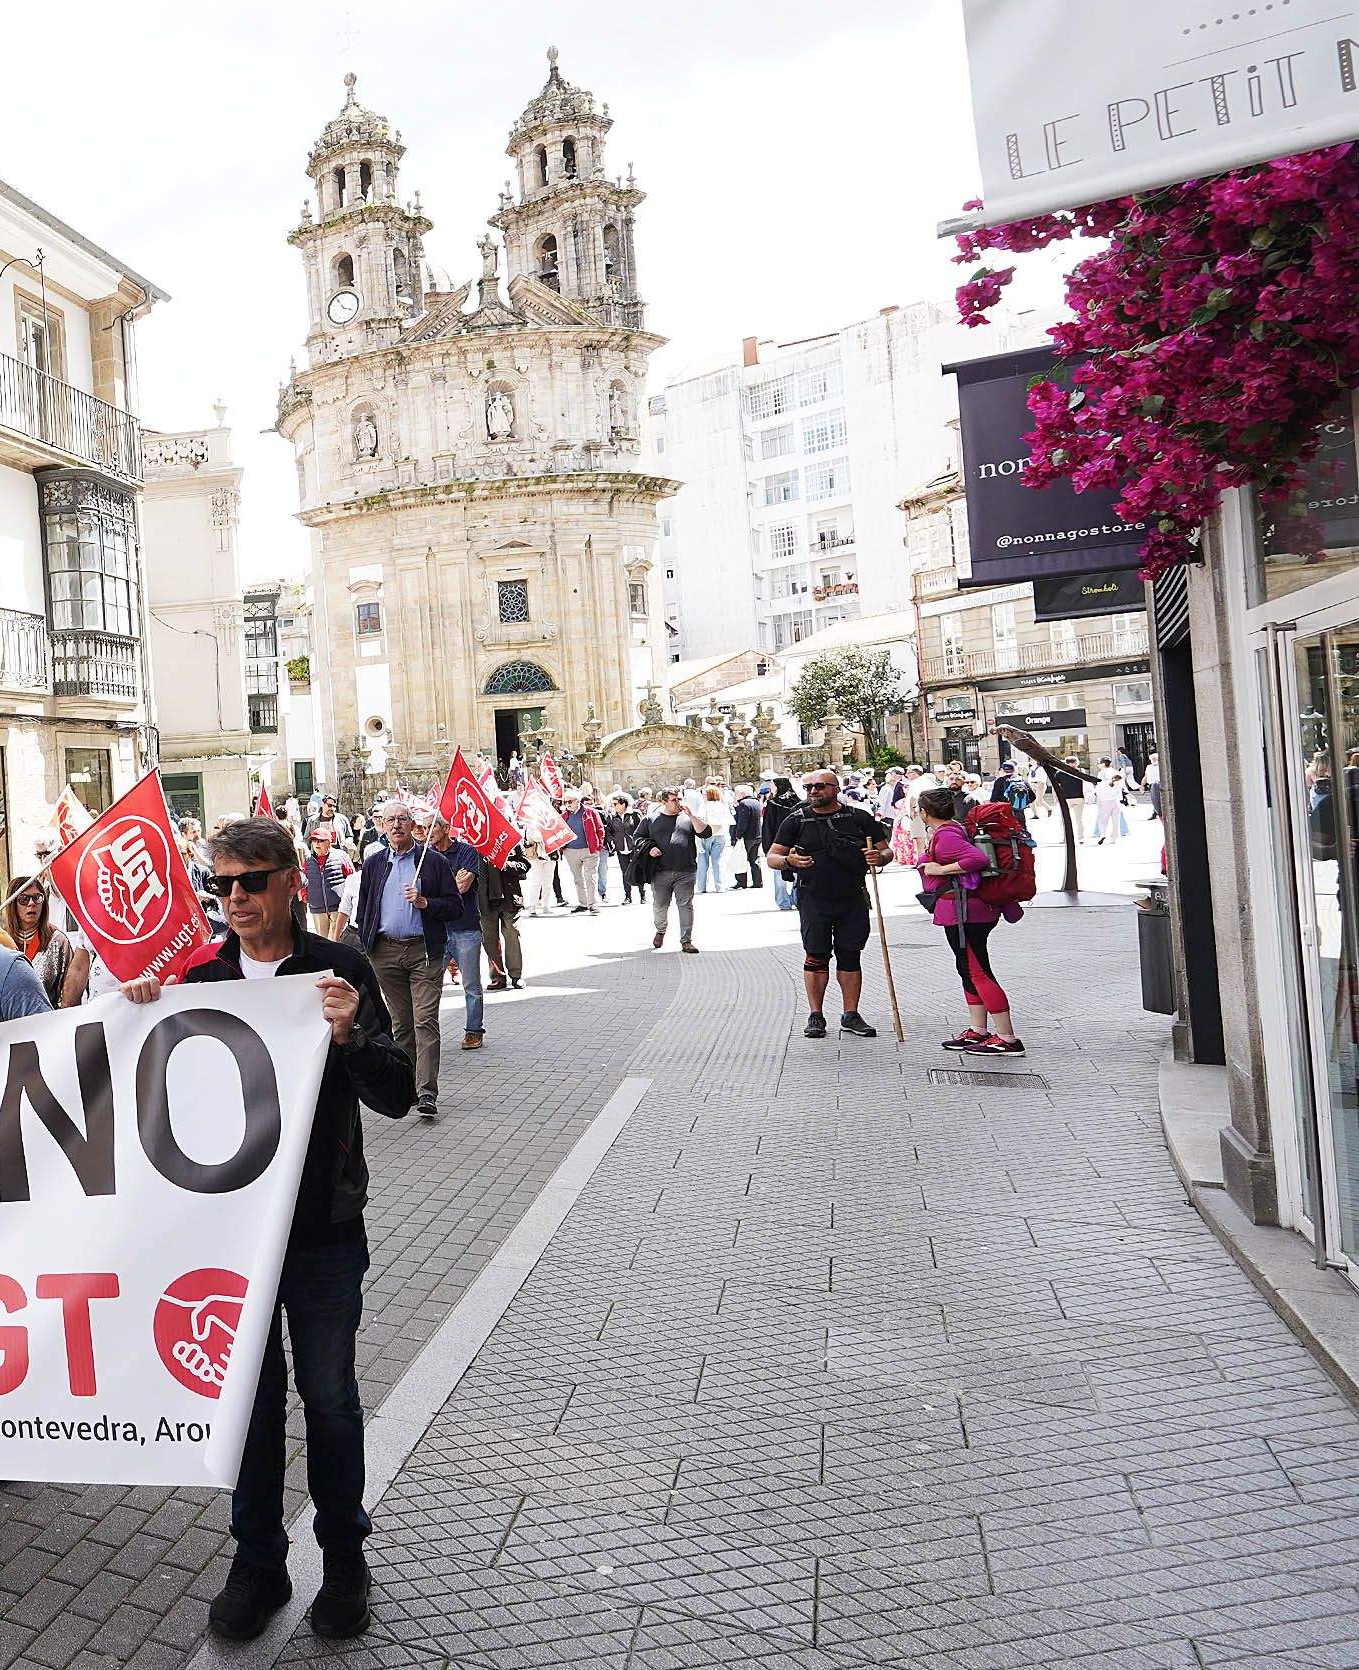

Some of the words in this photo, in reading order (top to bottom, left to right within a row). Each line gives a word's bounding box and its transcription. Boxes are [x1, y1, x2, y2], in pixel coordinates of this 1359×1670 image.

[1006, 113, 1084, 180] LE
[996, 522, 1146, 548] @nonnagostore
[1025, 715, 1051, 725] Orange
[110, 825, 166, 917] UGT
